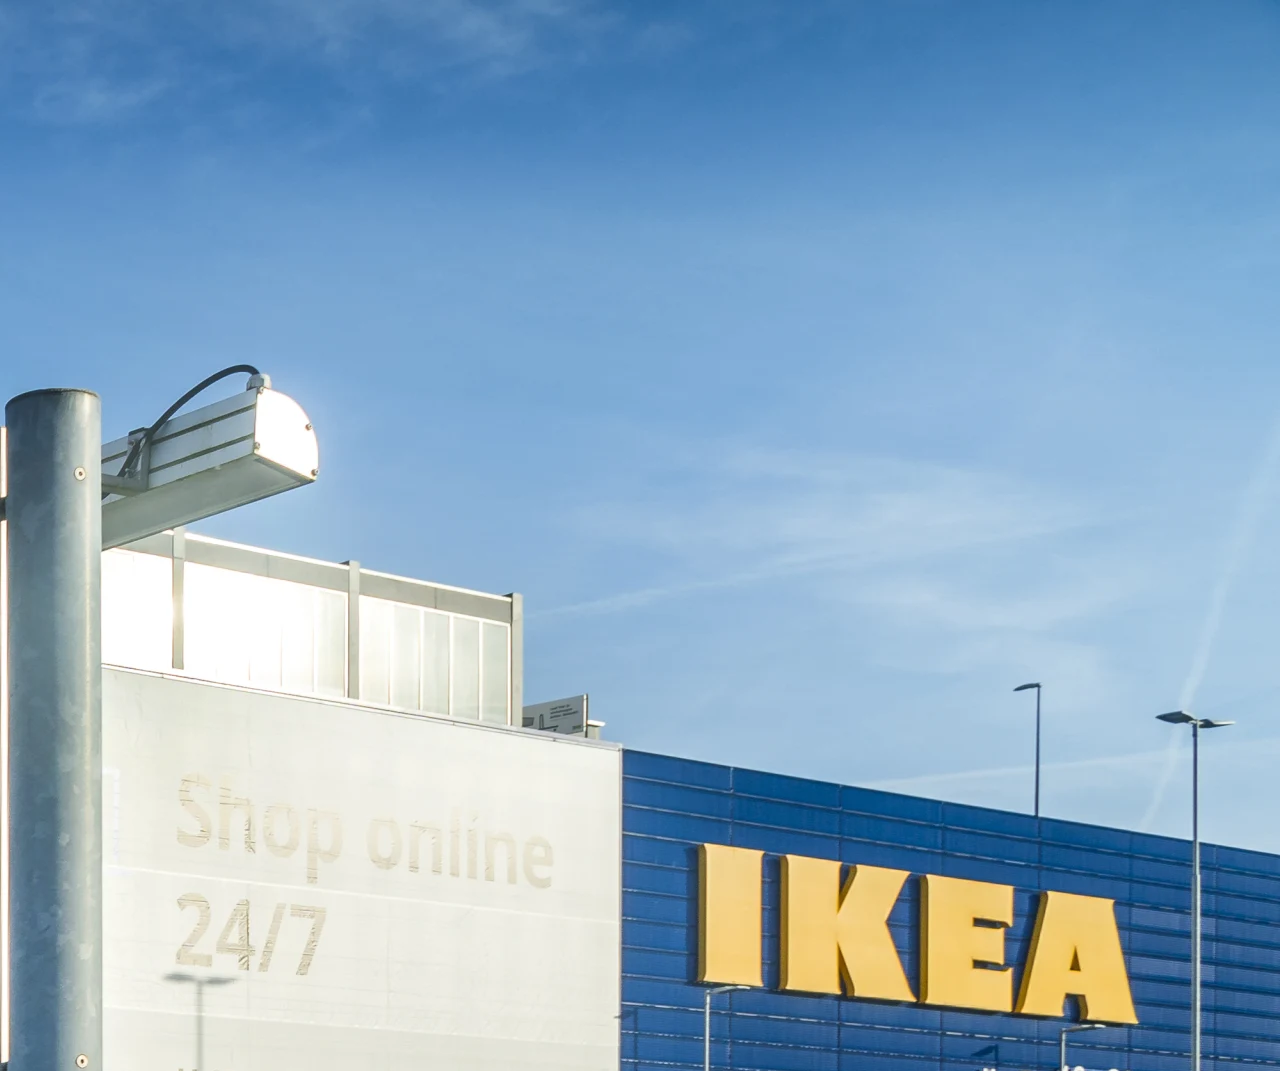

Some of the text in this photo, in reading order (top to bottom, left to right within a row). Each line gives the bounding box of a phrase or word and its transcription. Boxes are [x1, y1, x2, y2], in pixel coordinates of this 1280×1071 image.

[176, 772, 554, 889] Shop online
[175, 892, 327, 976] 24/7
[697, 843, 1138, 1025] IKEA
